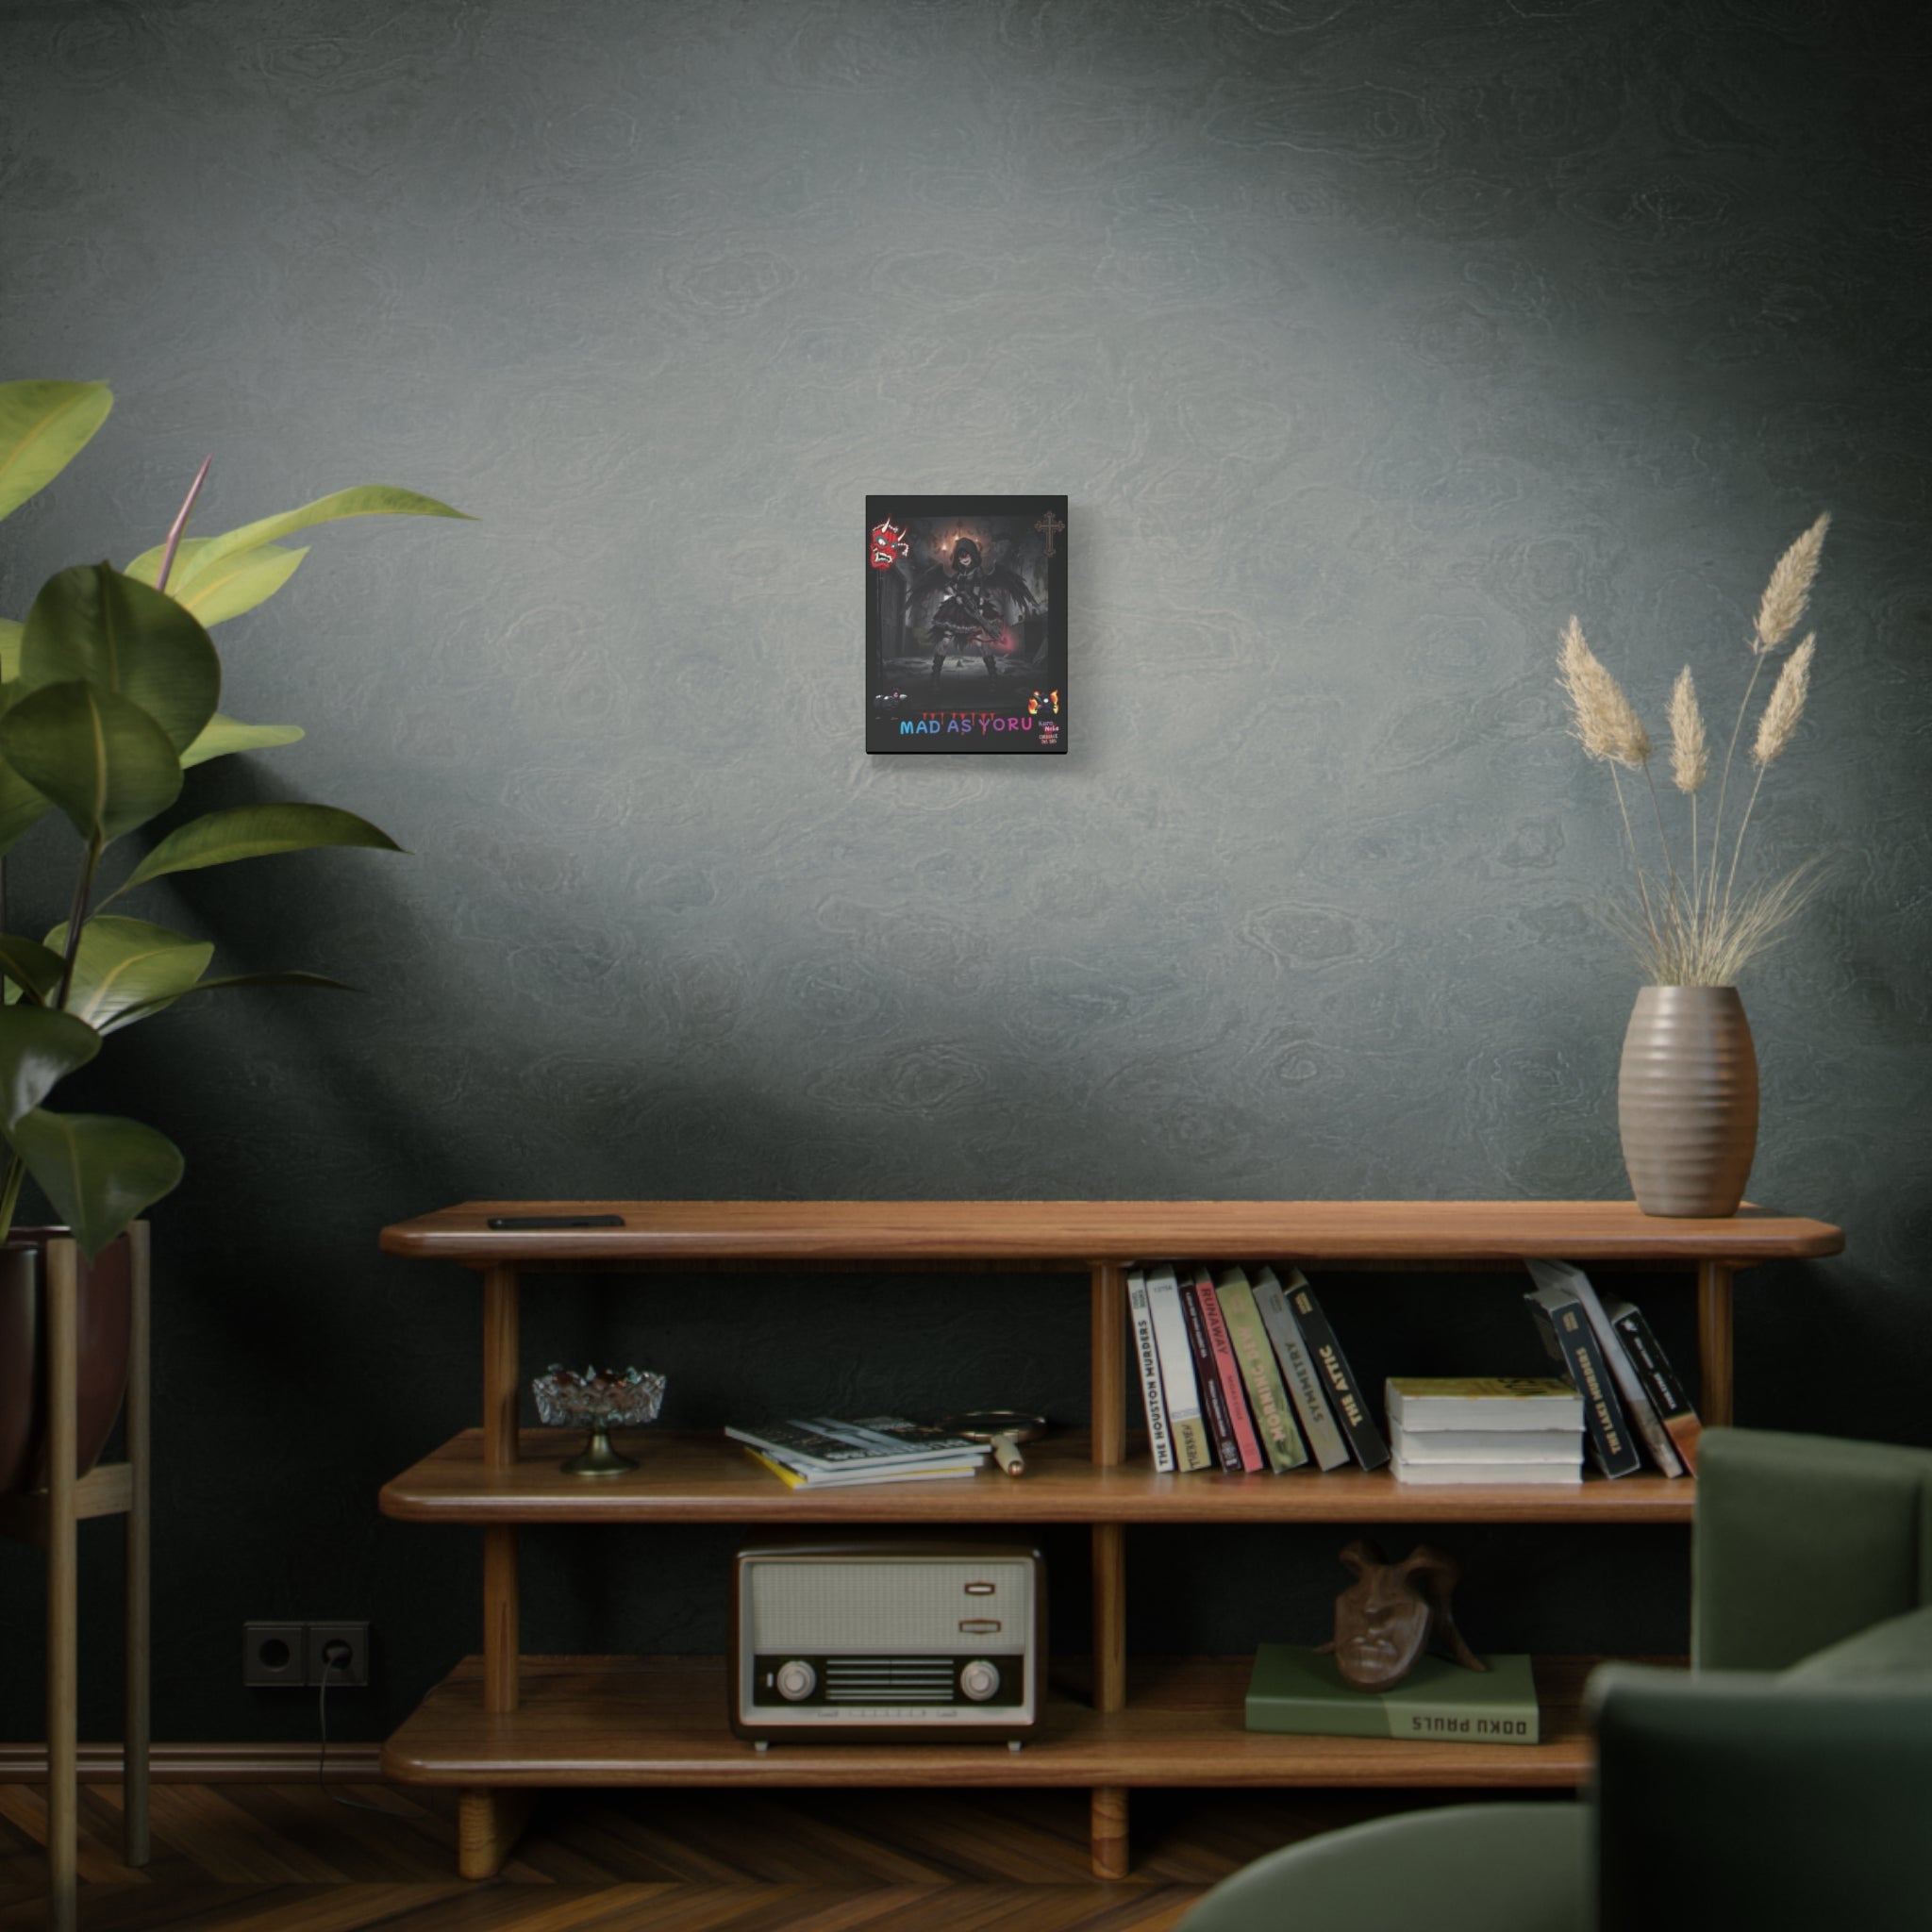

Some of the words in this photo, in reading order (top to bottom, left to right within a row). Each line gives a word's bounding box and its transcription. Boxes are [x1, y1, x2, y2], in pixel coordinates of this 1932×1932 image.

[900, 720, 941, 735] MAD
[947, 719, 972, 733] AS
[978, 717, 1033, 733] YORU
[1201, 1288, 1228, 1355] RUNAWAY
[1138, 1320, 1155, 1377] MURDERS
[1238, 1326, 1259, 1360] DEW
[1285, 1341, 1324, 1423] SYMMETRY
[1319, 1345, 1349, 1391] ATTIC
[1575, 1347, 1603, 1402] MURDERS
[1147, 1380, 1164, 1437] HOUSTON
[1251, 1364, 1286, 1441] MORNING
[1340, 1393, 1363, 1427] THE
[1594, 1402, 1613, 1431] LAKE
[1157, 1442, 1169, 1466] THE
[1606, 1431, 1622, 1456] THE
[1412, 1717, 1471, 1733] PAULS
